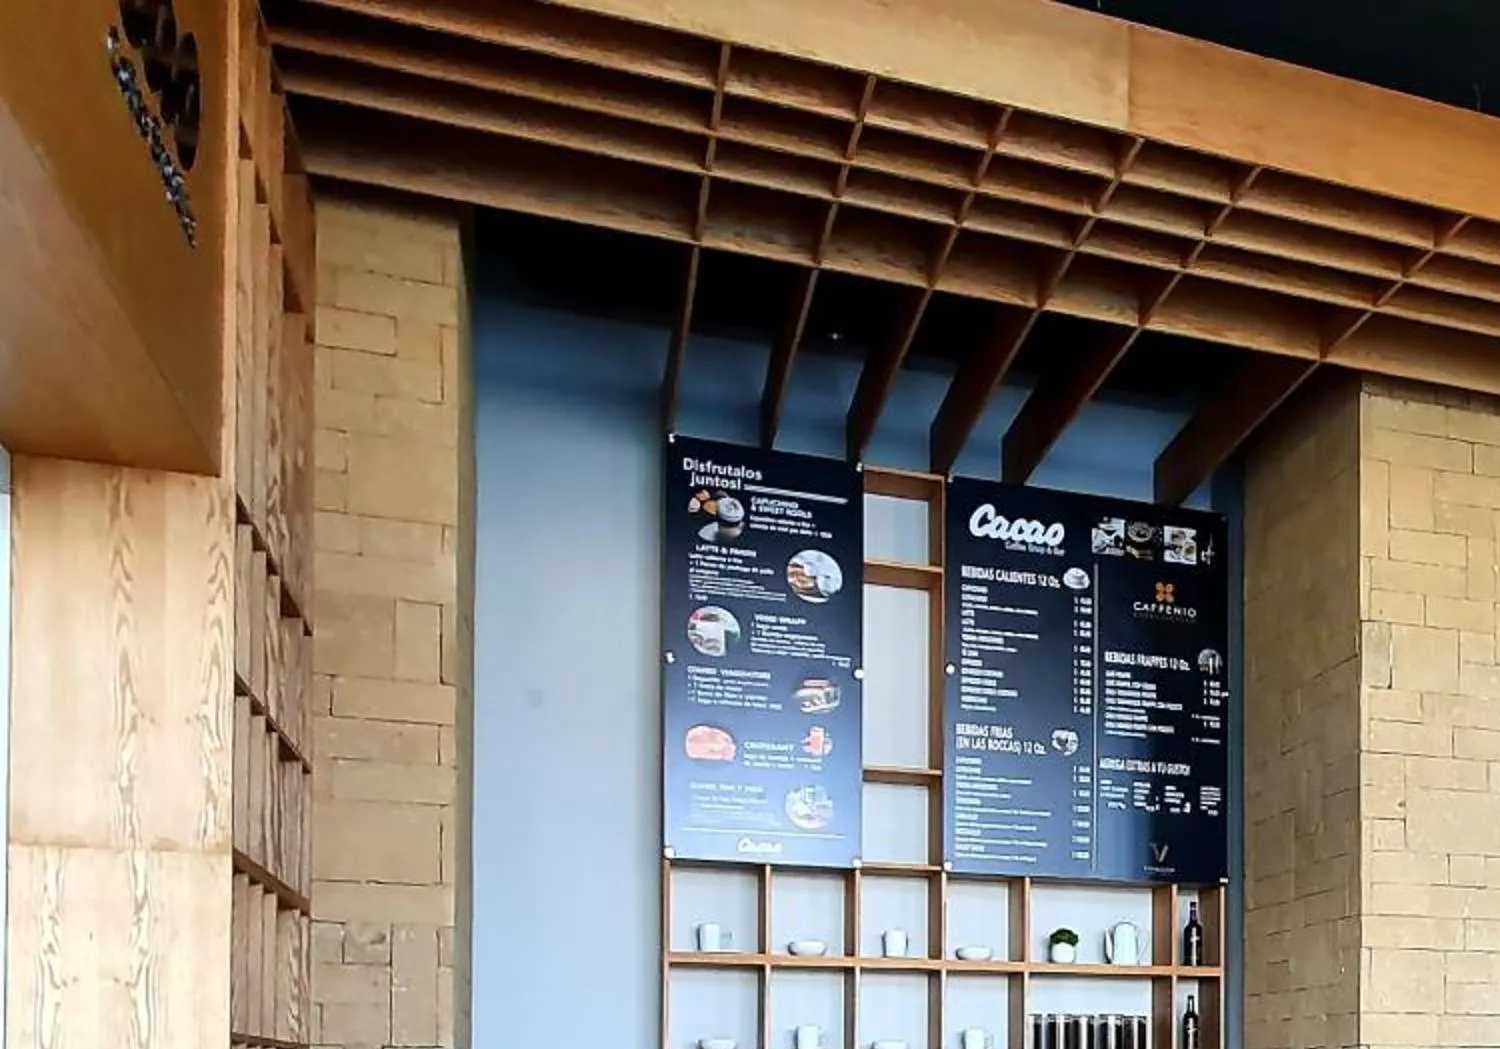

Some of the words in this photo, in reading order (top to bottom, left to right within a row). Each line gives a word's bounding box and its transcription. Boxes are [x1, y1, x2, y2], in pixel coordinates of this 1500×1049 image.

[969, 503, 1065, 547] Cacao
[995, 569, 1037, 585] CALIENTES
[972, 737, 987, 751] LAS
